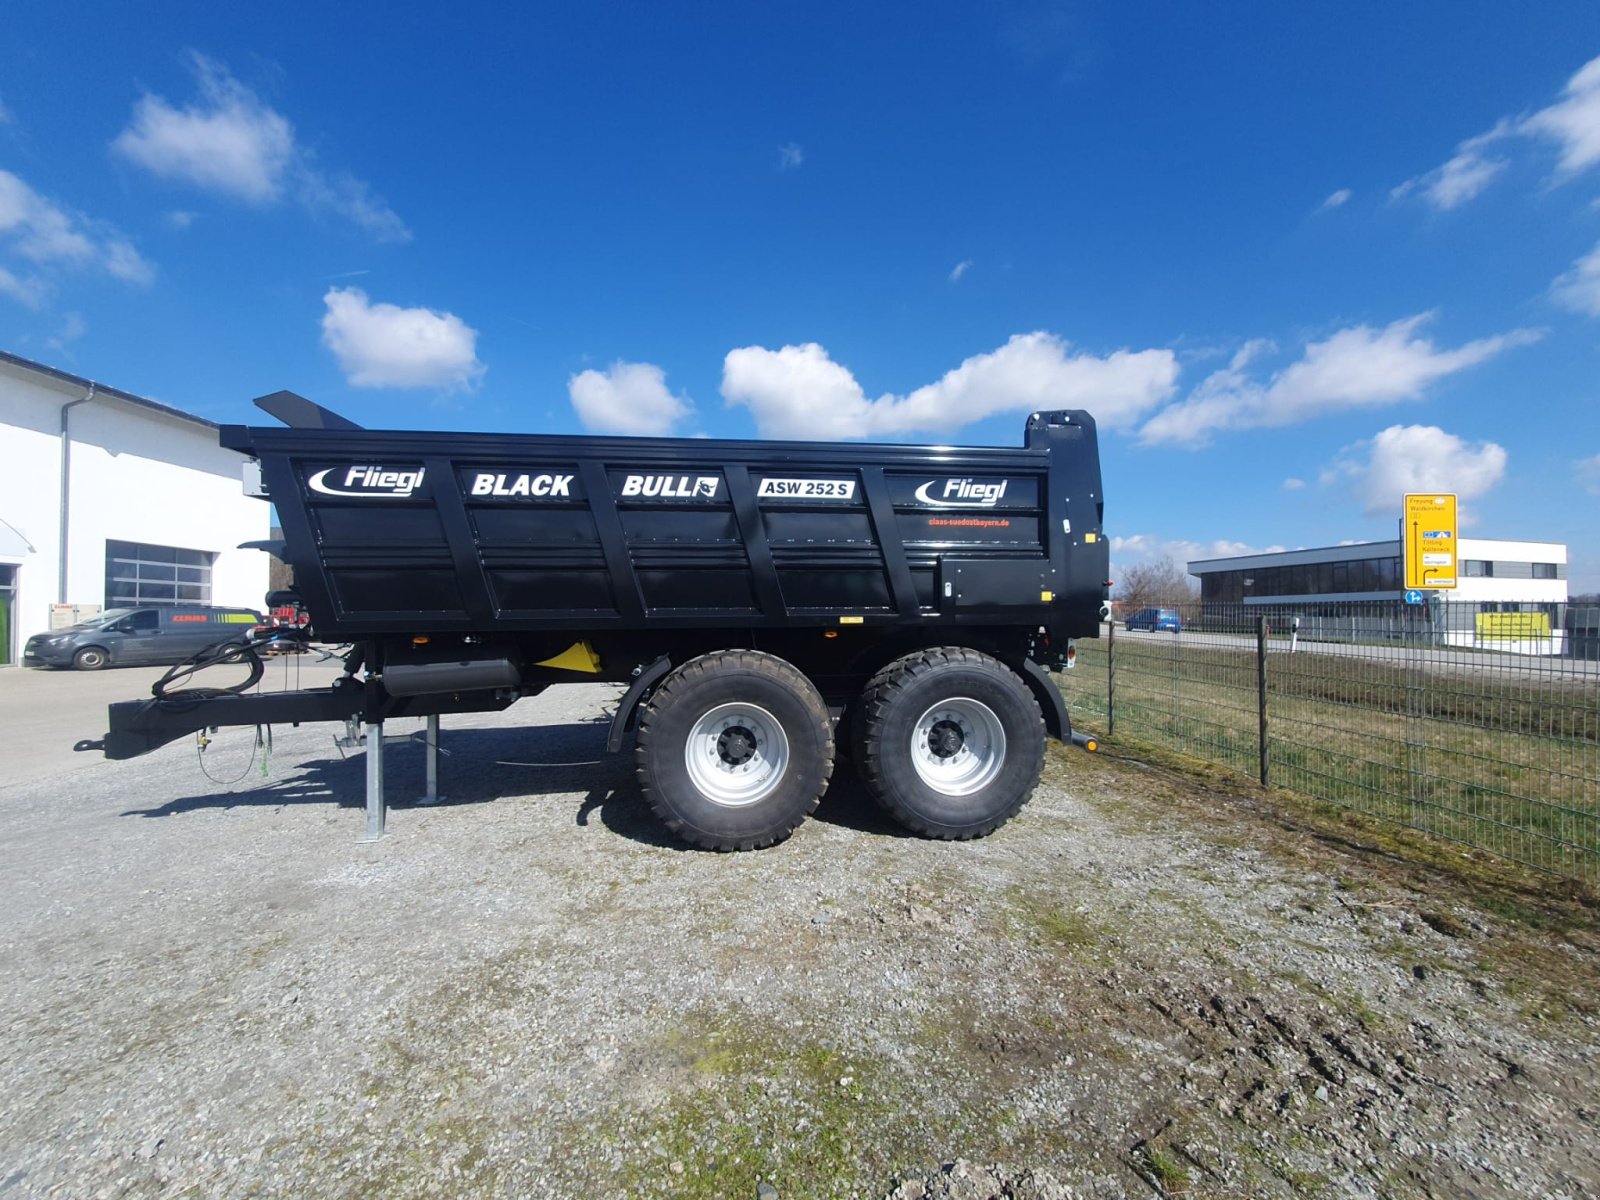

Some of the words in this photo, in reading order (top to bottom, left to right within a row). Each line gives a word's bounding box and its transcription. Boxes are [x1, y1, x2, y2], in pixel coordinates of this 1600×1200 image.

[344, 466, 426, 493] Fliegl
[471, 474, 574, 496] BLACK
[621, 475, 699, 497] BULL
[765, 481, 800, 495] ASW
[805, 482, 834, 495] 252
[837, 483, 848, 496] S
[942, 478, 1008, 503] Fliegl
